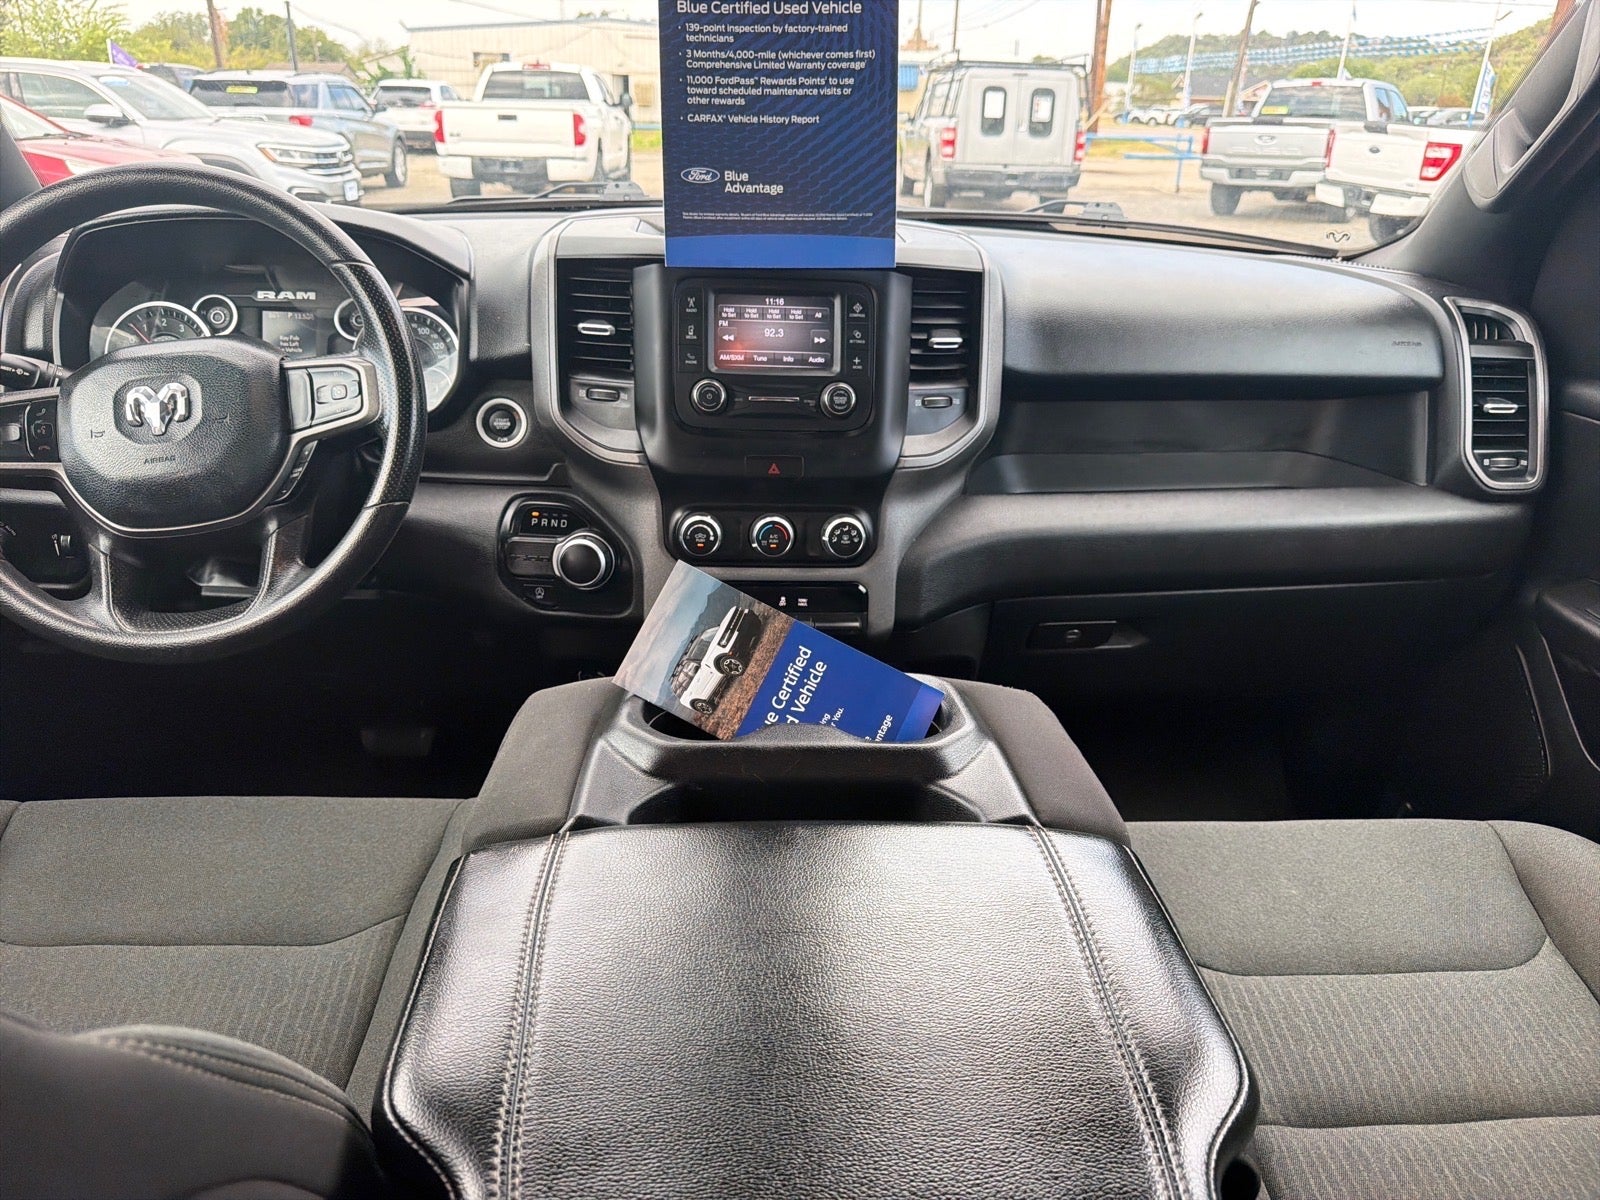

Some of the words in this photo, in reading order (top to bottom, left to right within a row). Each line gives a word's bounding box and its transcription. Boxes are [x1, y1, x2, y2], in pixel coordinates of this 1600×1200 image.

[677, 0, 708, 14] Blue
[711, 0, 770, 14] Certified
[773, 1, 809, 14] Used
[812, 0, 862, 14] Vehicle
[685, 23, 725, 33] 139-point
[727, 24, 771, 34] inspection
[772, 24, 783, 34] by
[784, 24, 848, 34] factory-trained
[686, 34, 735, 42] technicians
[686, 50, 692, 58] 3
[693, 50, 776, 60] Months/4,000-mile
[778, 50, 824, 60] (whichever
[855, 49, 876, 58] first)
[686, 60, 752, 70] Comprehensive
[754, 61, 786, 70] Limited
[787, 61, 827, 70] Warranty
[686, 76, 713, 85] 11,000
[760, 77, 796, 86] Rewards
[687, 86, 718, 94] toward
[719, 86, 762, 96] scheduled
[764, 87, 818, 96] maintenance
[820, 87, 842, 95] visits
[687, 96, 710, 104] other
[711, 97, 746, 106] rewards
[728, 114, 758, 124] Vehicle
[760, 115, 790, 125] History
[791, 115, 820, 124] Report
[724, 170, 749, 182] Blue
[724, 182, 784, 196] Advantage
[256, 290, 316, 300] RAM
[161, 318, 168, 326] 2
[179, 324, 185, 332] 3
[764, 328, 784, 338] 92.3
[772, 645, 812, 709] Certified
[790, 661, 827, 712] Vehicle
[832, 707, 844, 722] You.
[874, 714, 893, 742] ntage
